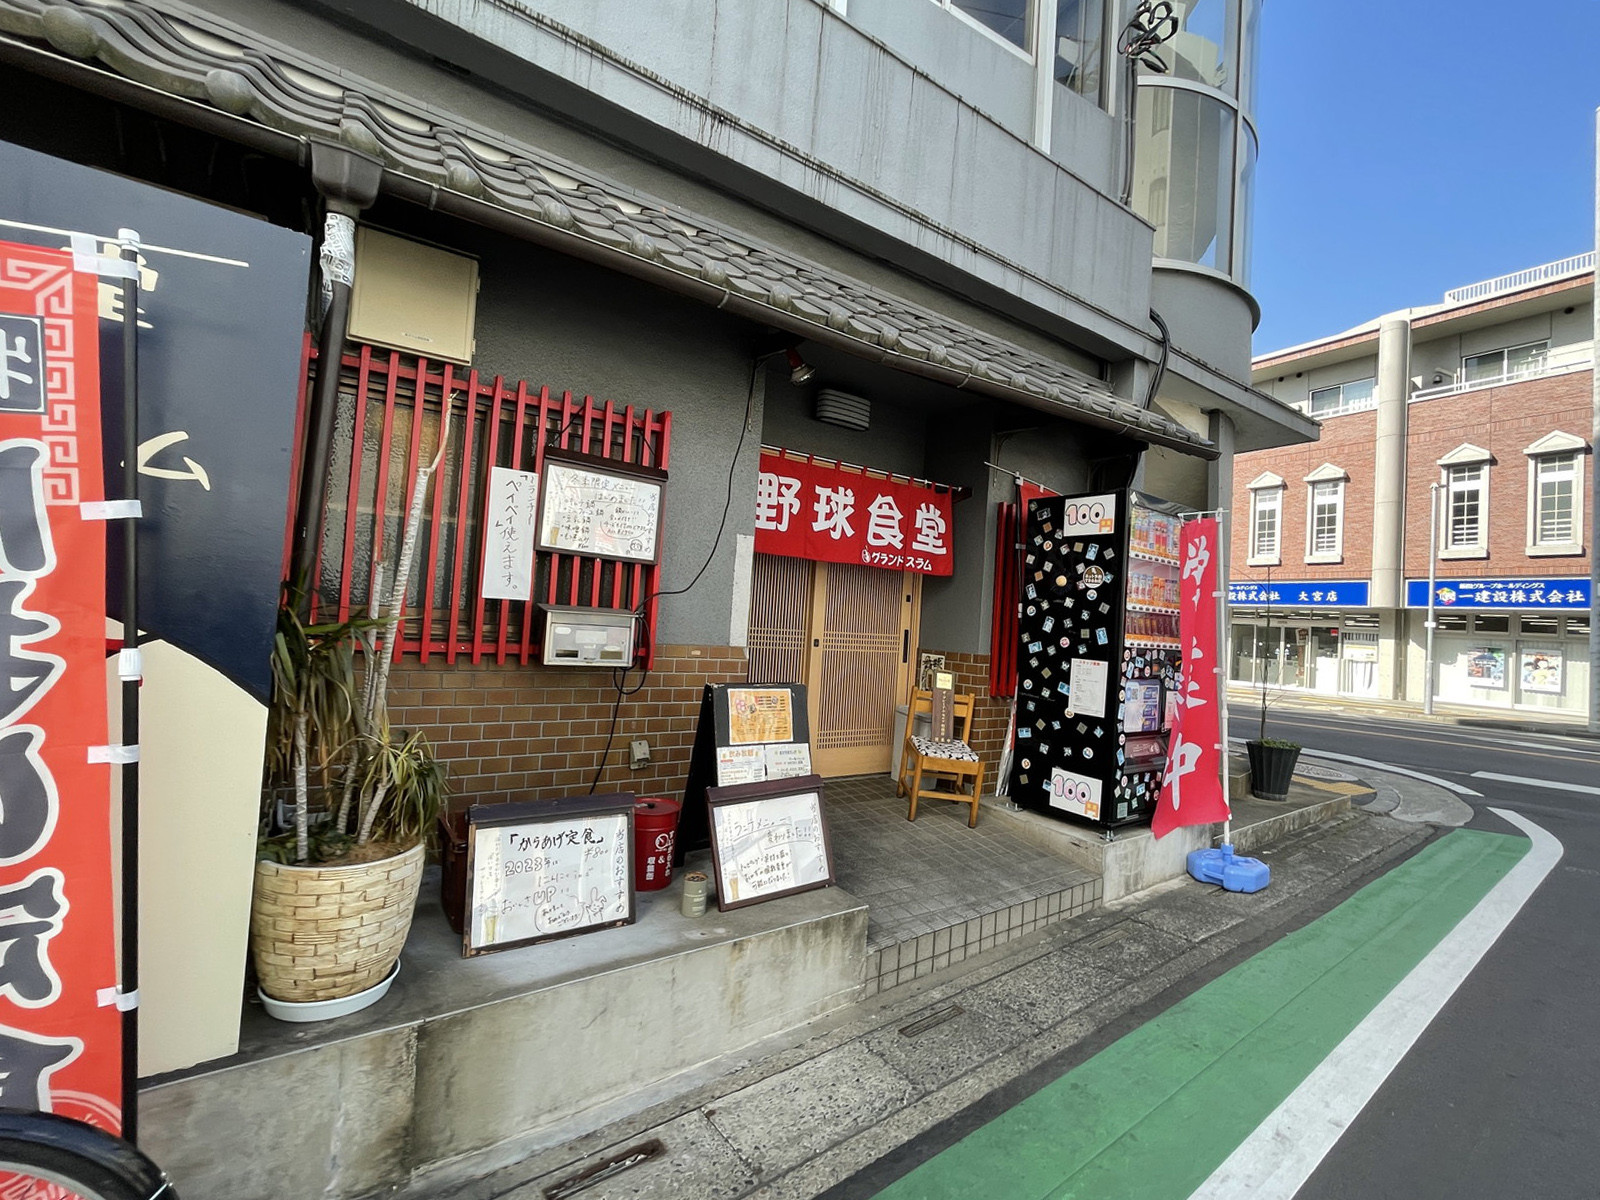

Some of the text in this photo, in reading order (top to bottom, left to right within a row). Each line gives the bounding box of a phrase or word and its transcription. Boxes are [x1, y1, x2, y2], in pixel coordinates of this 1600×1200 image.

[756, 472, 946, 555] 野球食堂
[871, 552, 932, 571] グランドスラム
[1298, 590, 1338, 602] 大宮店
[1458, 589, 1586, 604] 一建設株式会社
